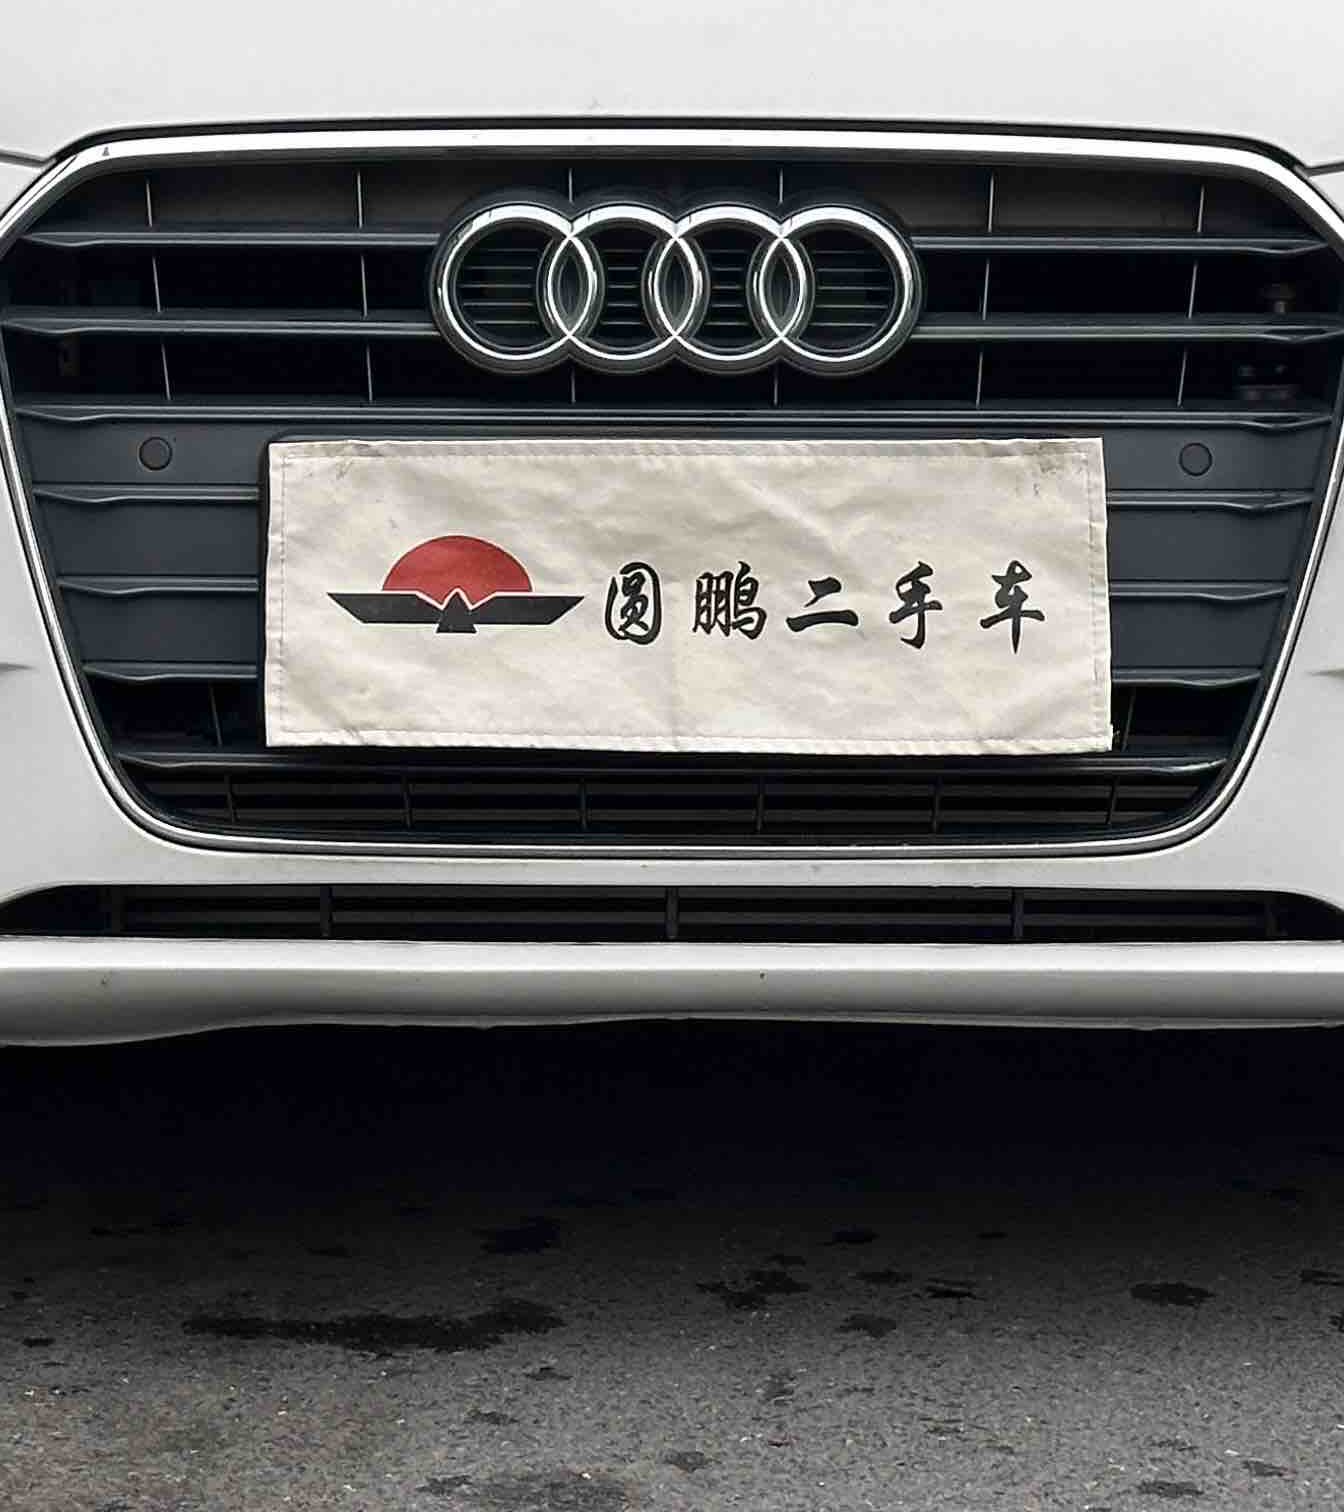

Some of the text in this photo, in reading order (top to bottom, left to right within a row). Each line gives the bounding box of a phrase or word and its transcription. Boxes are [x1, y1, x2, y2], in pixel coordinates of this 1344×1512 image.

[605, 561, 1047, 655] 圆鹏二手车
